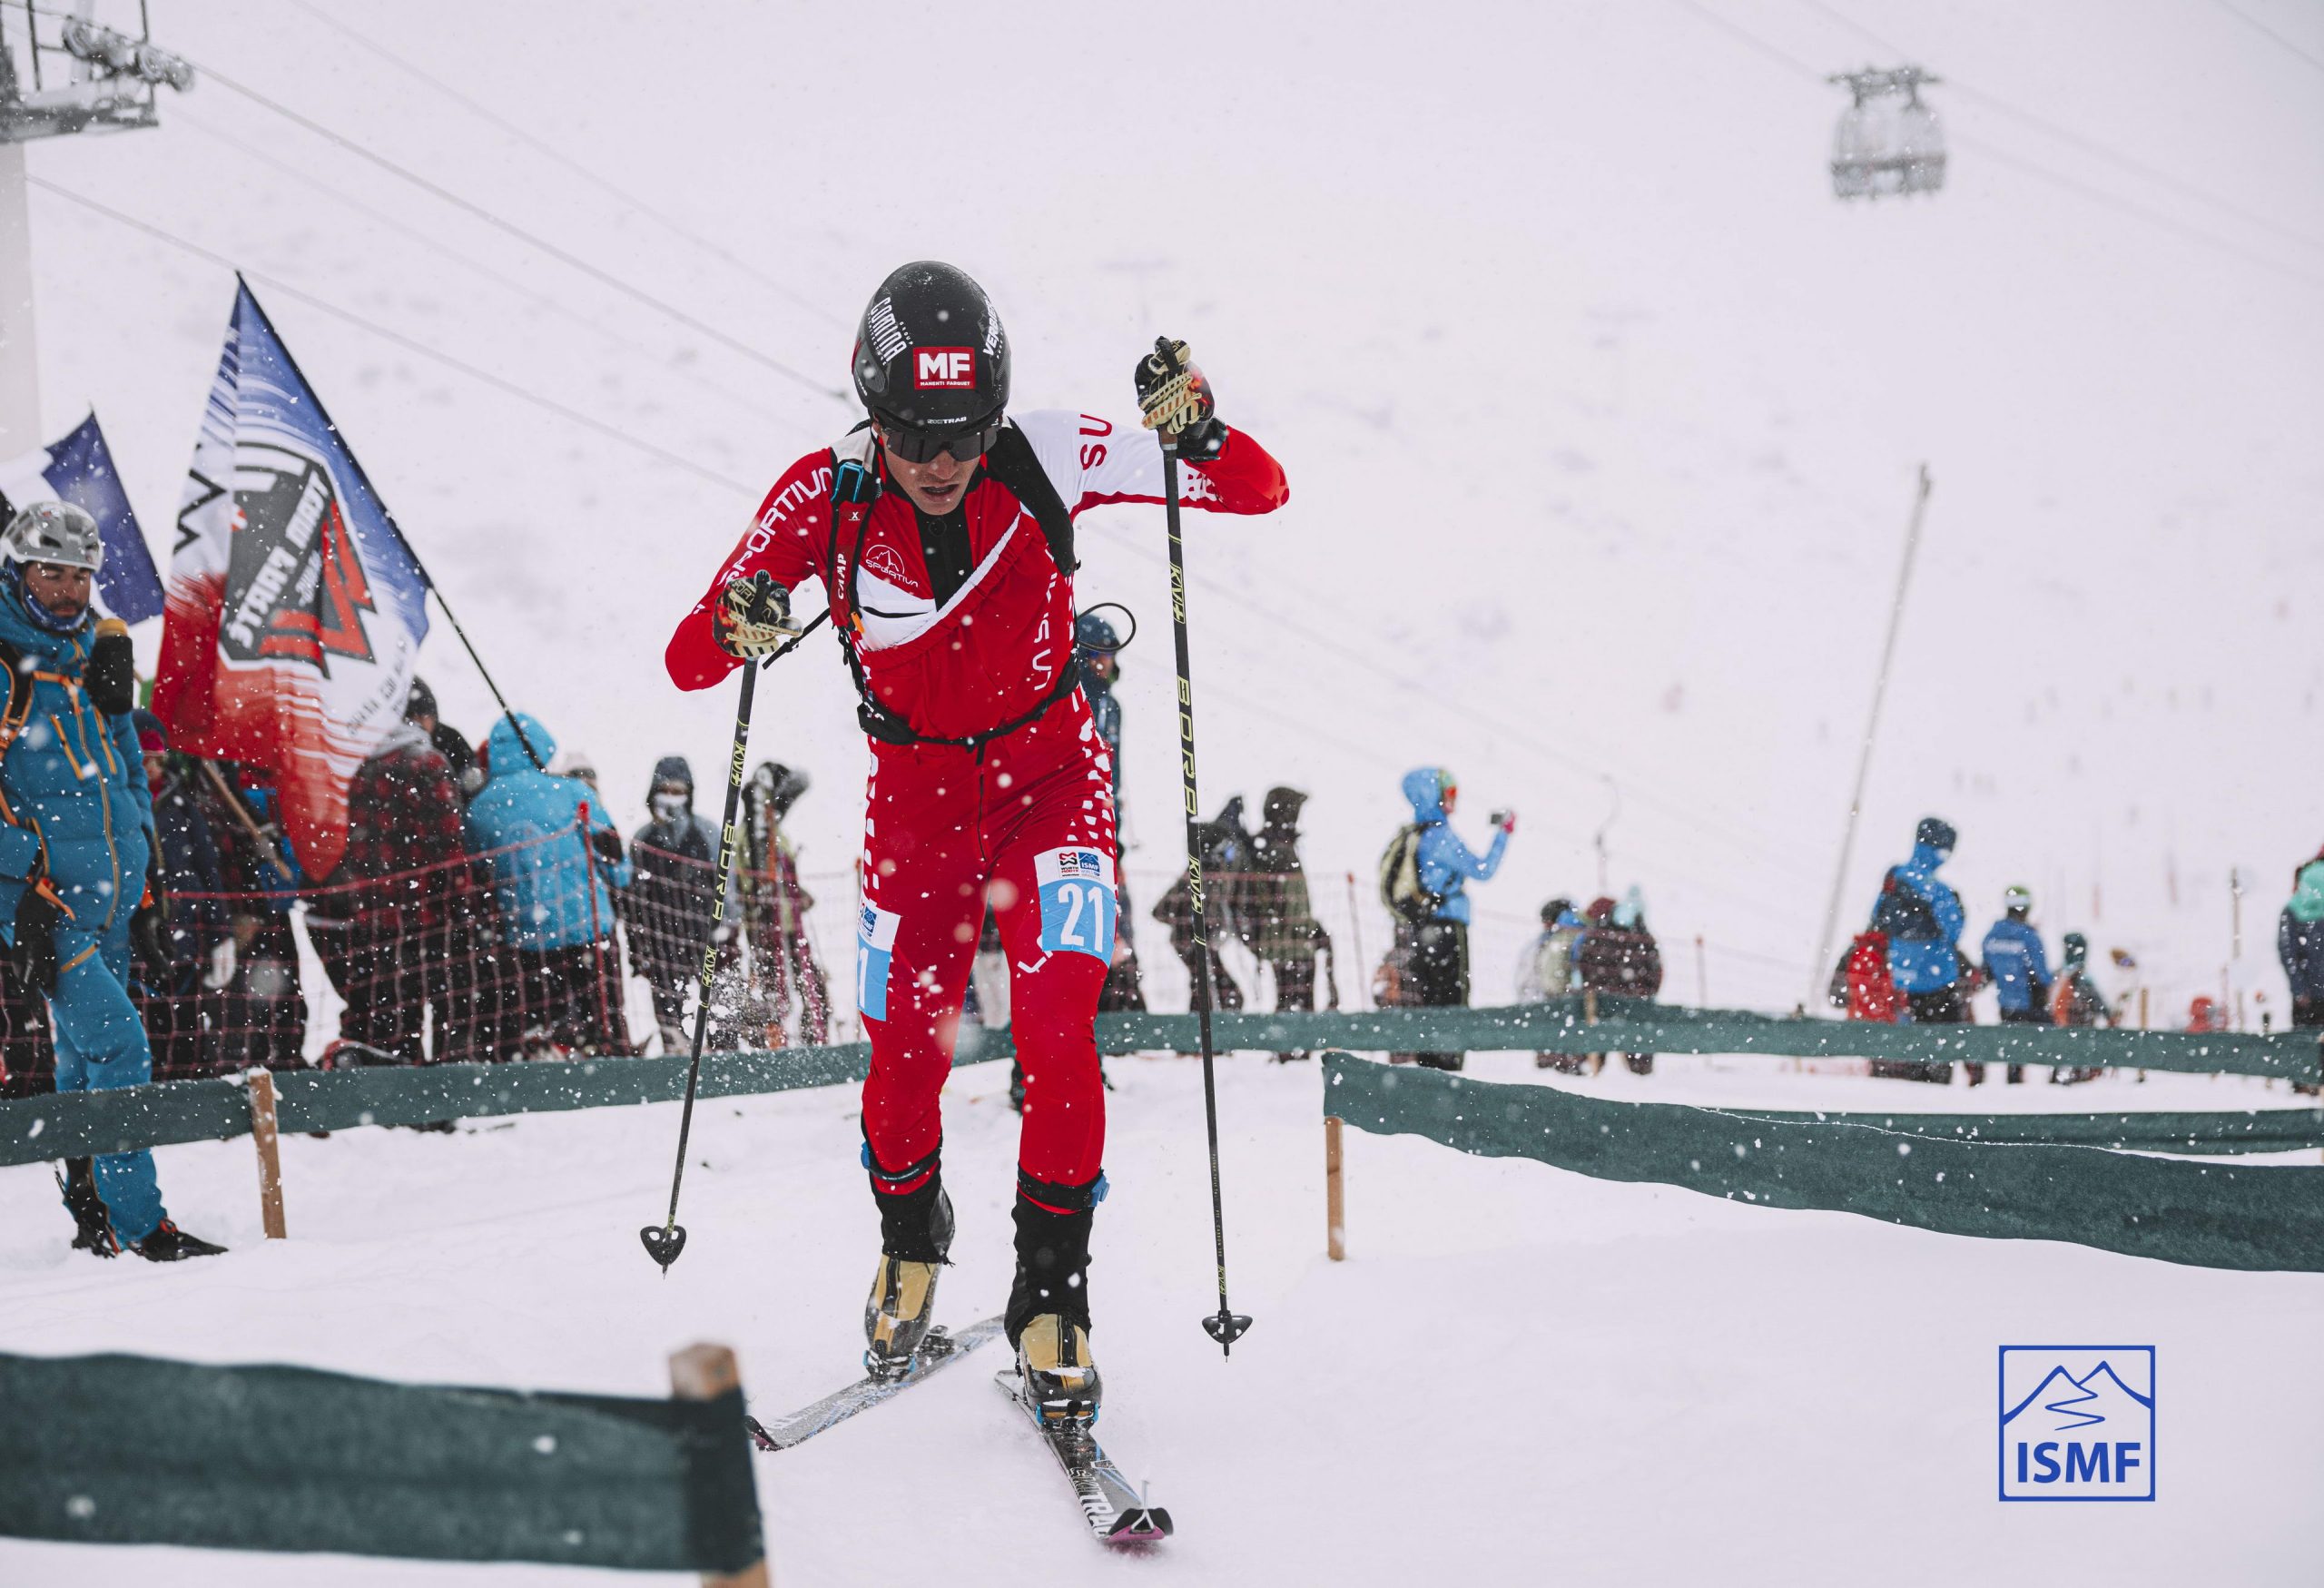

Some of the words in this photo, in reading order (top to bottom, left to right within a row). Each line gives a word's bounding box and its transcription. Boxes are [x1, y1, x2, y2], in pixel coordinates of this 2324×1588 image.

[871, 297, 908, 362] COMINA
[919, 352, 970, 380] MF
[836, 552, 847, 600] CAMP
[865, 558, 919, 588] SPORTIVA
[1177, 675, 1196, 815] BORA
[713, 822, 735, 921] BORA
[1058, 883, 1104, 953] 21
